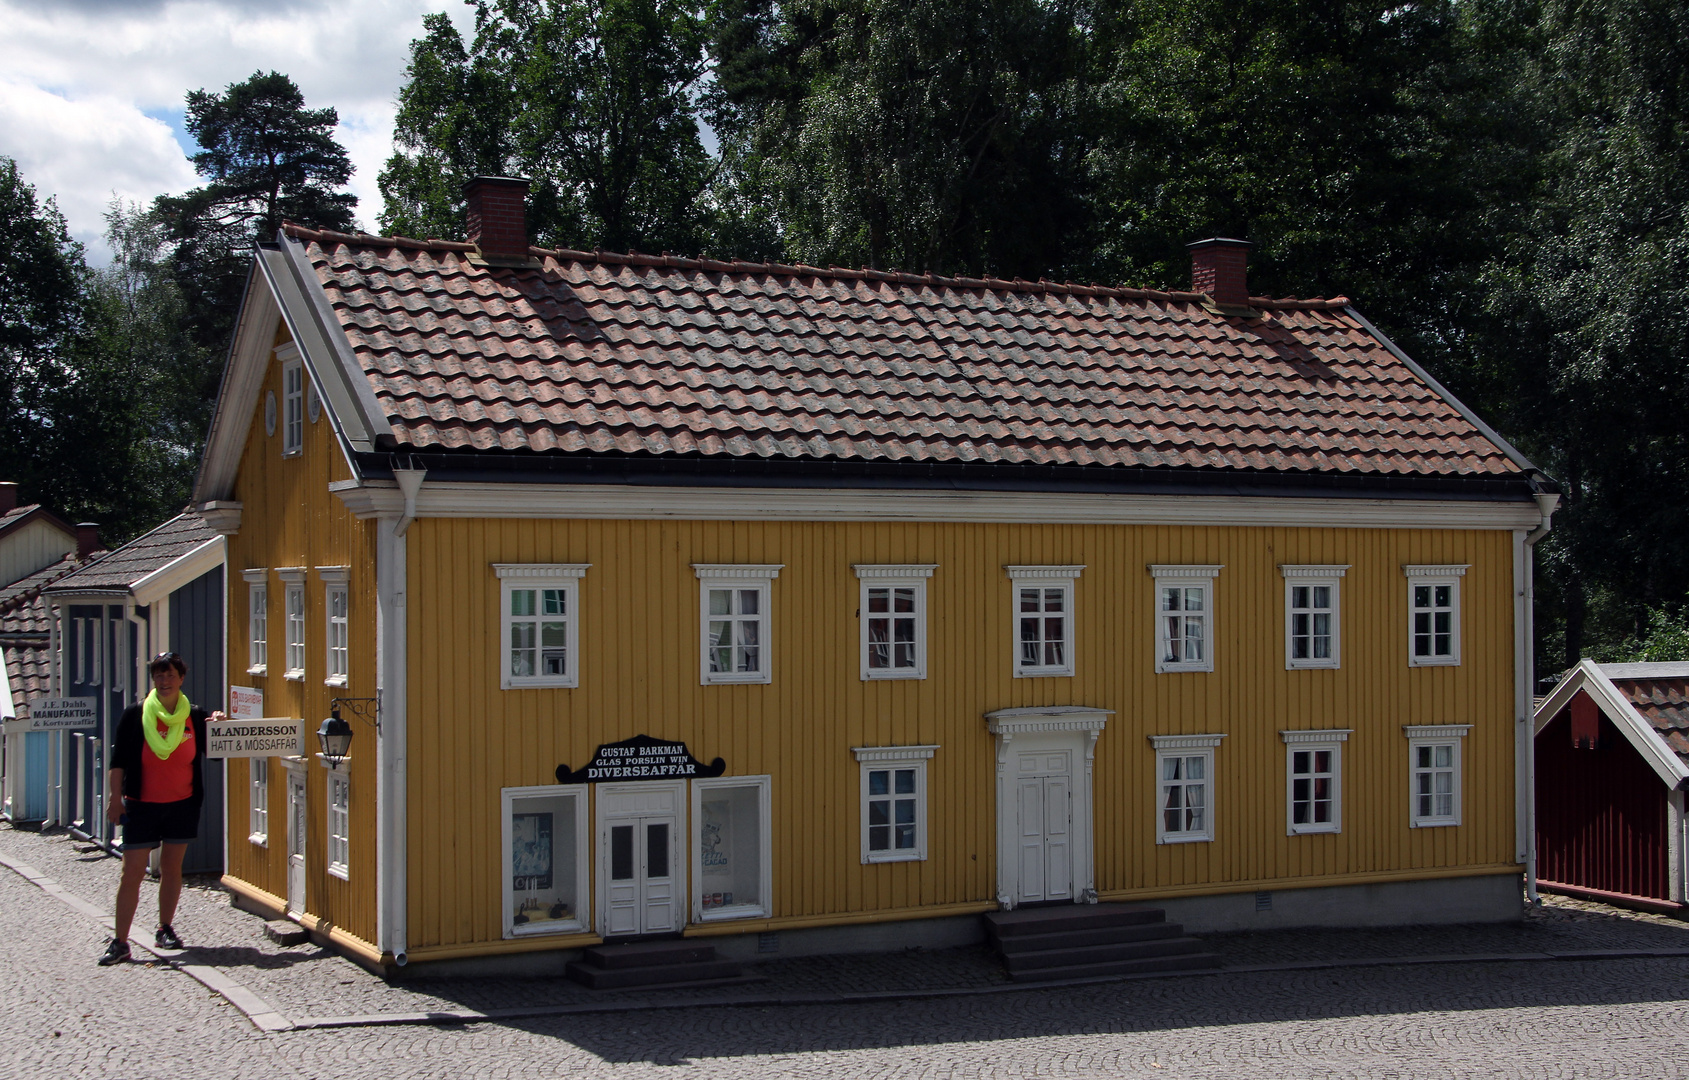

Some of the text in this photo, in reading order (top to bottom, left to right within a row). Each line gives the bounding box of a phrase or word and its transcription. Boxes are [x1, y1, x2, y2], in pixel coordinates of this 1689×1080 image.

[42, 700, 87, 709] J.E. Dahls
[33, 709, 96, 719] MANUFAKTUR-
[211, 725, 297, 737] M.ANDERSSON
[211, 737, 297, 752] HATT & MÖSSAFFÄR
[601, 745, 683, 758] GUSTAF BARKMAN
[595, 755, 688, 767] GLAS PORSLIN WIN
[588, 762, 696, 778] DIVERSEAFFÄR
